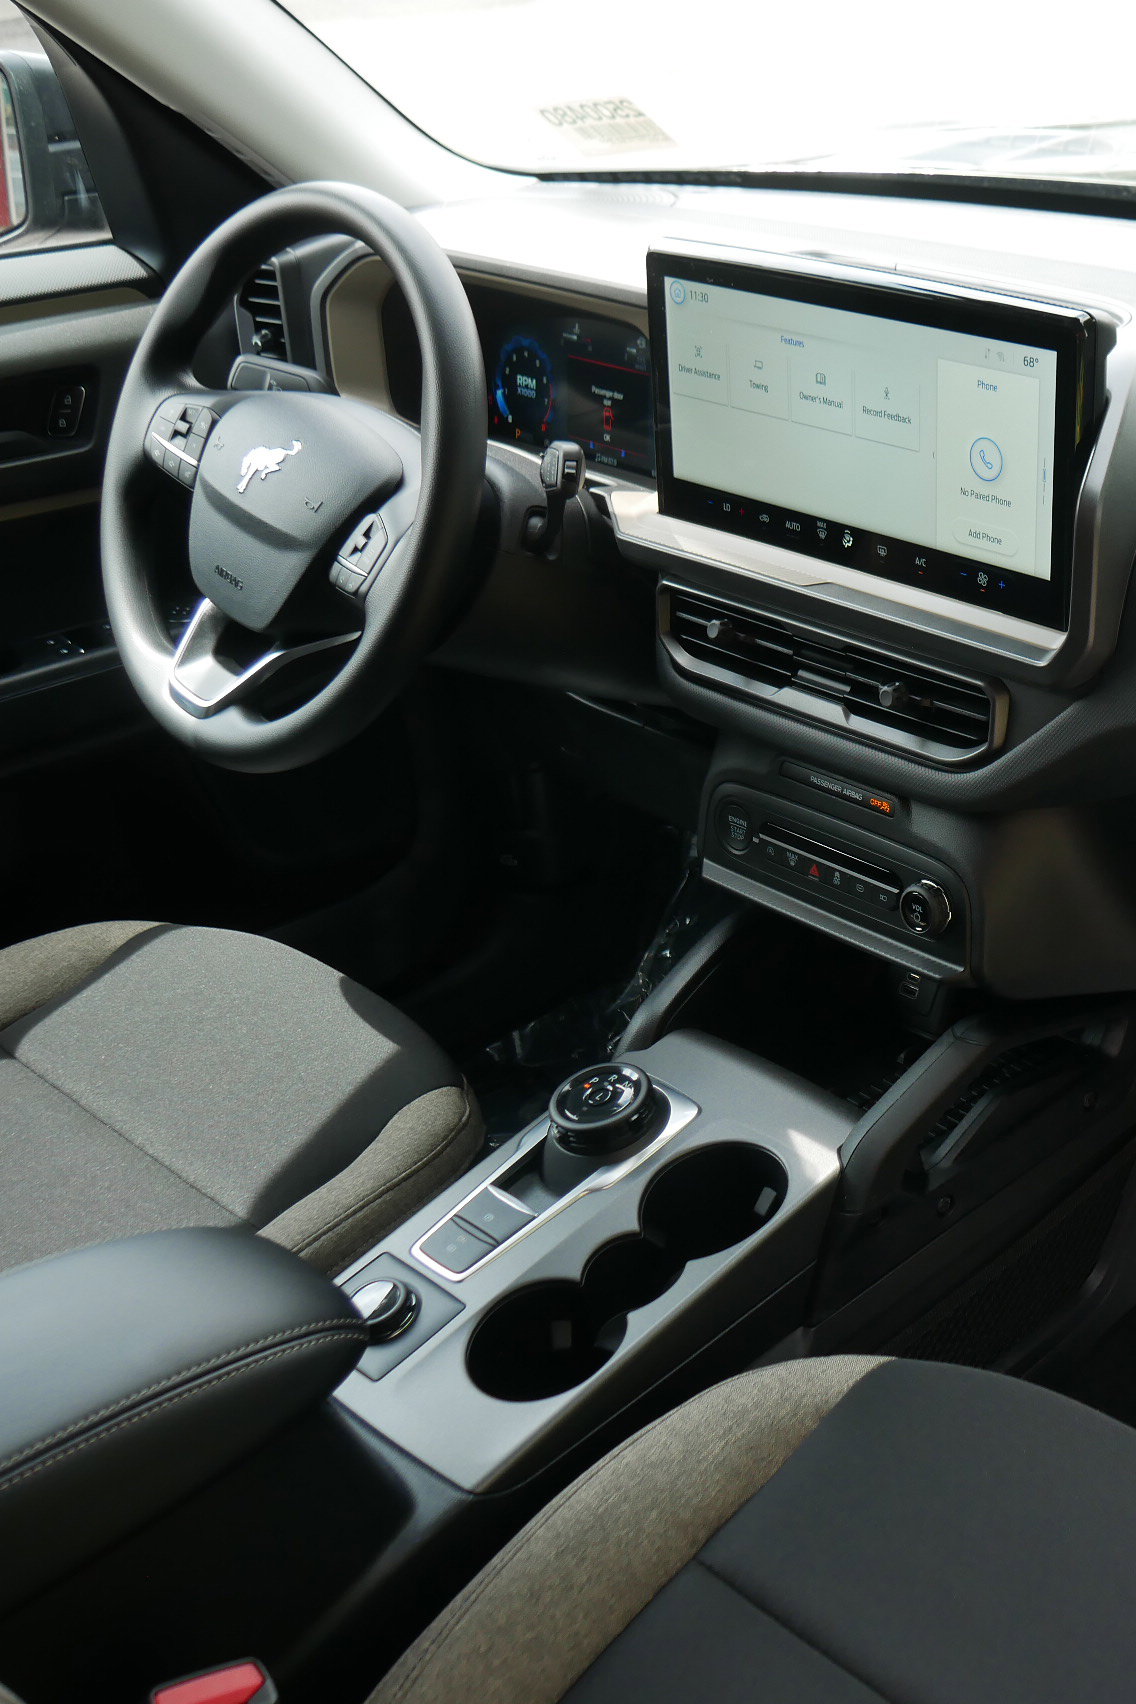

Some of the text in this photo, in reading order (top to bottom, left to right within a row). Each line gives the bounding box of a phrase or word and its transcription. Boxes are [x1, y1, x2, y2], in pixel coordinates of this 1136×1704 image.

[689, 290, 709, 303] 11:30
[780, 335, 805, 348] Features
[678, 363, 721, 381] Driver Assistance
[517, 374, 537, 389] RPM
[749, 380, 769, 393] Towing
[977, 379, 998, 392] Phone
[799, 391, 844, 409] Owner's Manual
[862, 405, 912, 425] Record Feedback
[960, 487, 1012, 508] No Paired Phone
[785, 520, 800, 532] AUTO
[968, 528, 1003, 546] Add Phone
[915, 555, 927, 568] A/C
[214, 565, 243, 591] AIRBAG
[810, 775, 842, 793] PASSENGER
[843, 788, 863, 801] AIRBAG
[911, 902, 924, 914] VOL
[589, 1076, 599, 1084] P
[608, 1074, 618, 1083] R
